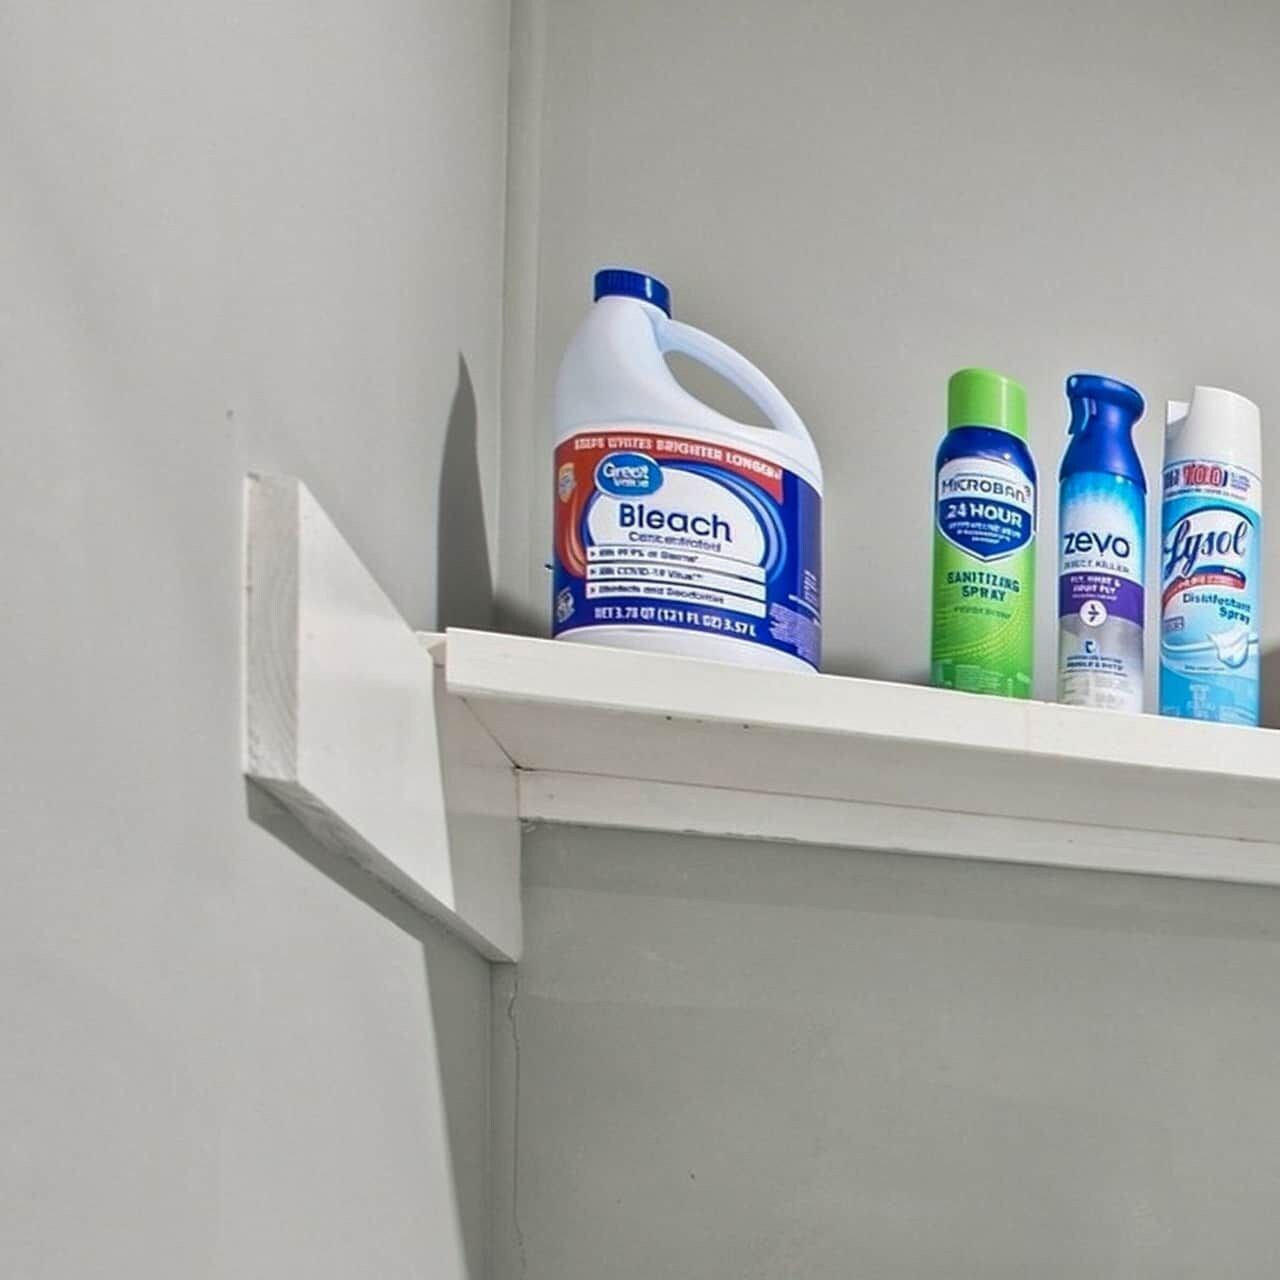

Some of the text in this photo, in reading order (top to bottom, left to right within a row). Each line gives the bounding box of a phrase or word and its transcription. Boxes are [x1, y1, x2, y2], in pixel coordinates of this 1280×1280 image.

[656, 439, 723, 460] BRIGHTER
[602, 462, 650, 480] Great
[613, 476, 650, 488] Value
[941, 478, 1026, 503] MICROBAN
[619, 503, 733, 543] Bleach
[946, 503, 1023, 528] 24 HOUR
[628, 531, 722, 552] Concentrated
[1063, 530, 1131, 559] zevo
[1162, 519, 1248, 581] Lysol
[946, 571, 1021, 593] SANITIZING
[961, 585, 1007, 602] SPRAY
[1182, 592, 1251, 613] Disinfectant
[1219, 606, 1251, 626] Spray
